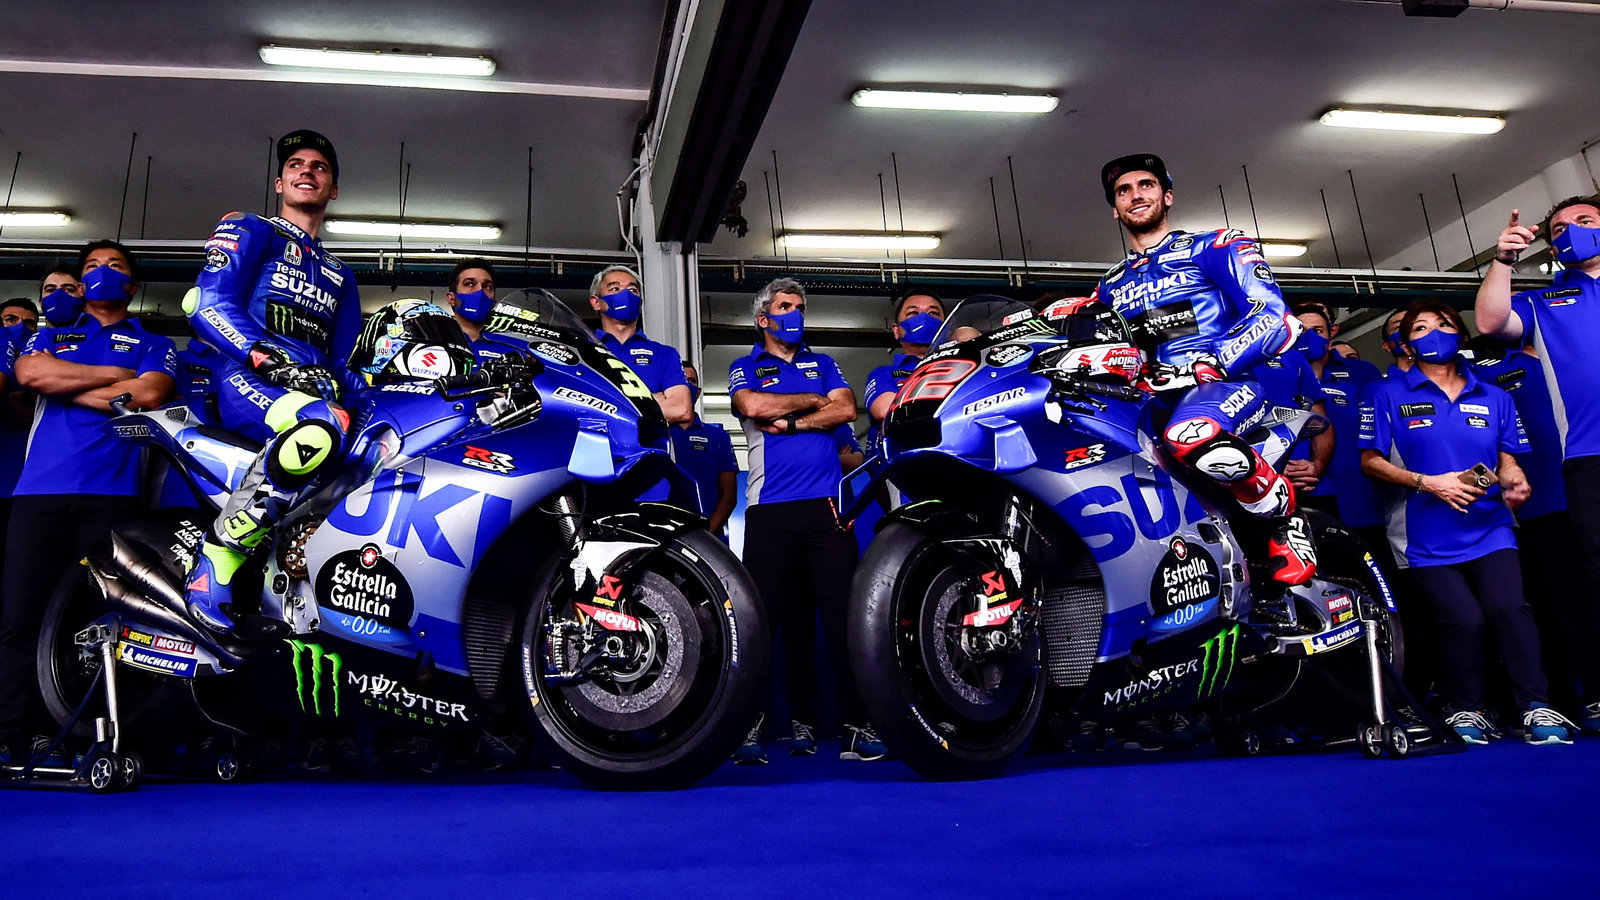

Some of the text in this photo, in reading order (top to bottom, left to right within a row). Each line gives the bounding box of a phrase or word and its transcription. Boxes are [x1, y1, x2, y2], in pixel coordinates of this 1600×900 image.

[275, 262, 307, 281] Team
[270, 272, 338, 313] SUZUKI
[294, 295, 324, 312] MotoGP
[1109, 281, 1136, 298] Team
[1112, 271, 1188, 311] SUZUKI
[201, 308, 248, 350] ECSTAR
[1223, 314, 1280, 365] ECSTAR
[381, 384, 436, 396] SUZUKI
[552, 387, 618, 415] ECSTAR
[964, 388, 1025, 416] ECSTAR
[1219, 384, 1257, 418] SUZUKI
[178, 529, 198, 547] NGK
[331, 562, 397, 600] Estrella
[1163, 556, 1209, 588] Estrella
[1371, 566, 1395, 608] MICHELIN
[330, 584, 391, 618] Galicia
[1166, 580, 1211, 606] Galicia
[1328, 596, 1350, 611] MOTUL
[593, 609, 637, 632] MOTUL
[1326, 625, 1360, 645] MICHELIN
[156, 638, 194, 653] MOTUL
[730, 616, 739, 662] MICHELIN
[134, 653, 189, 671] MICHELIN
[522, 647, 536, 692] MICHELIN
[348, 670, 470, 722] MONSTER
[1103, 658, 1199, 706] MONSTER
[364, 698, 449, 728] ENERGY
[911, 706, 941, 740] MICHELIN
